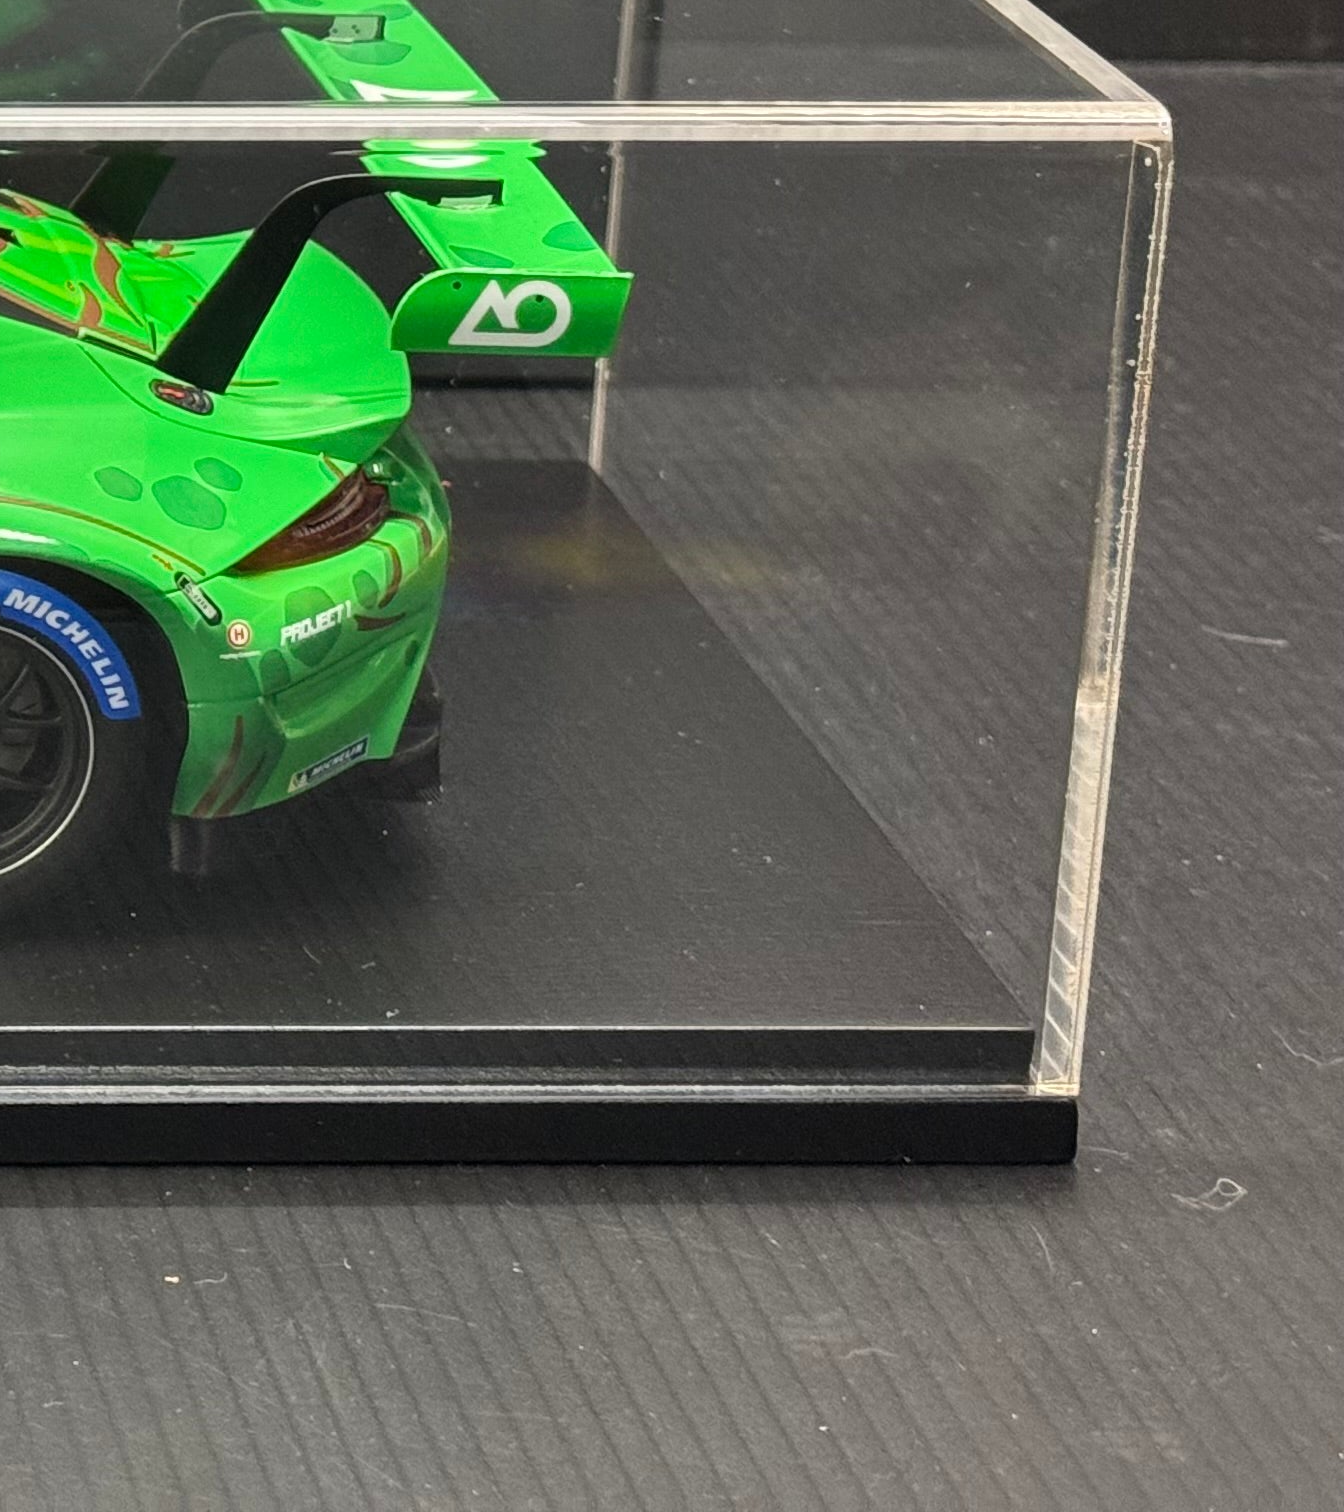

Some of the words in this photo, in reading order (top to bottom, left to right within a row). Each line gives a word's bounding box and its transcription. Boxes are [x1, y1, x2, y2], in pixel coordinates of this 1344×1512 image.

[3, 588, 130, 712] MICHELIN
[279, 603, 345, 647] PROJECT
[344, 600, 352, 619] 1
